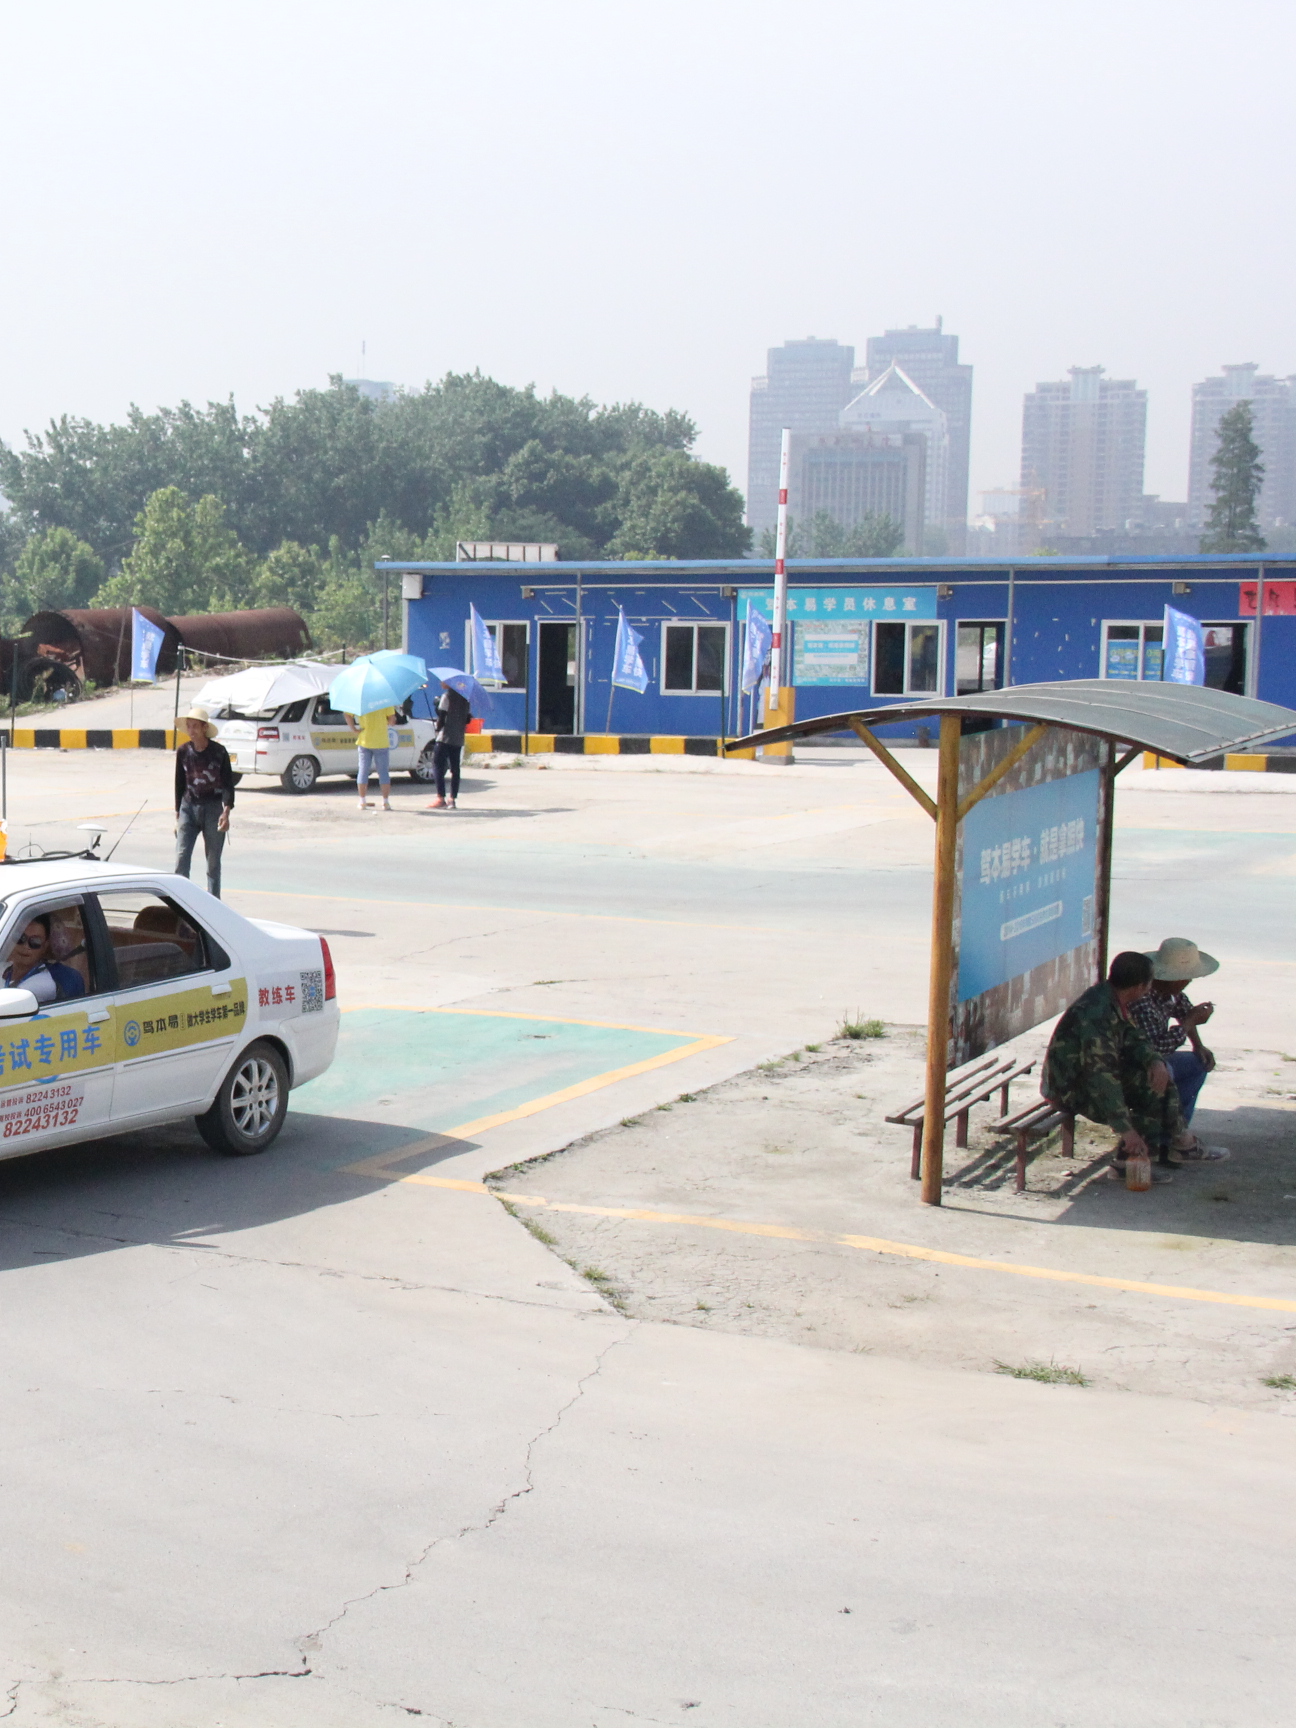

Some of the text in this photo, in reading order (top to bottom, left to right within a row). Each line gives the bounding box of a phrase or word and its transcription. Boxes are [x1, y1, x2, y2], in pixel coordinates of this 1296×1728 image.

[258, 985, 296, 1007] 教练车
[143, 1014, 179, 1034] 驾本易
[25, 1085, 72, 1104] 82243132
[2, 1108, 79, 1138] 82243132
